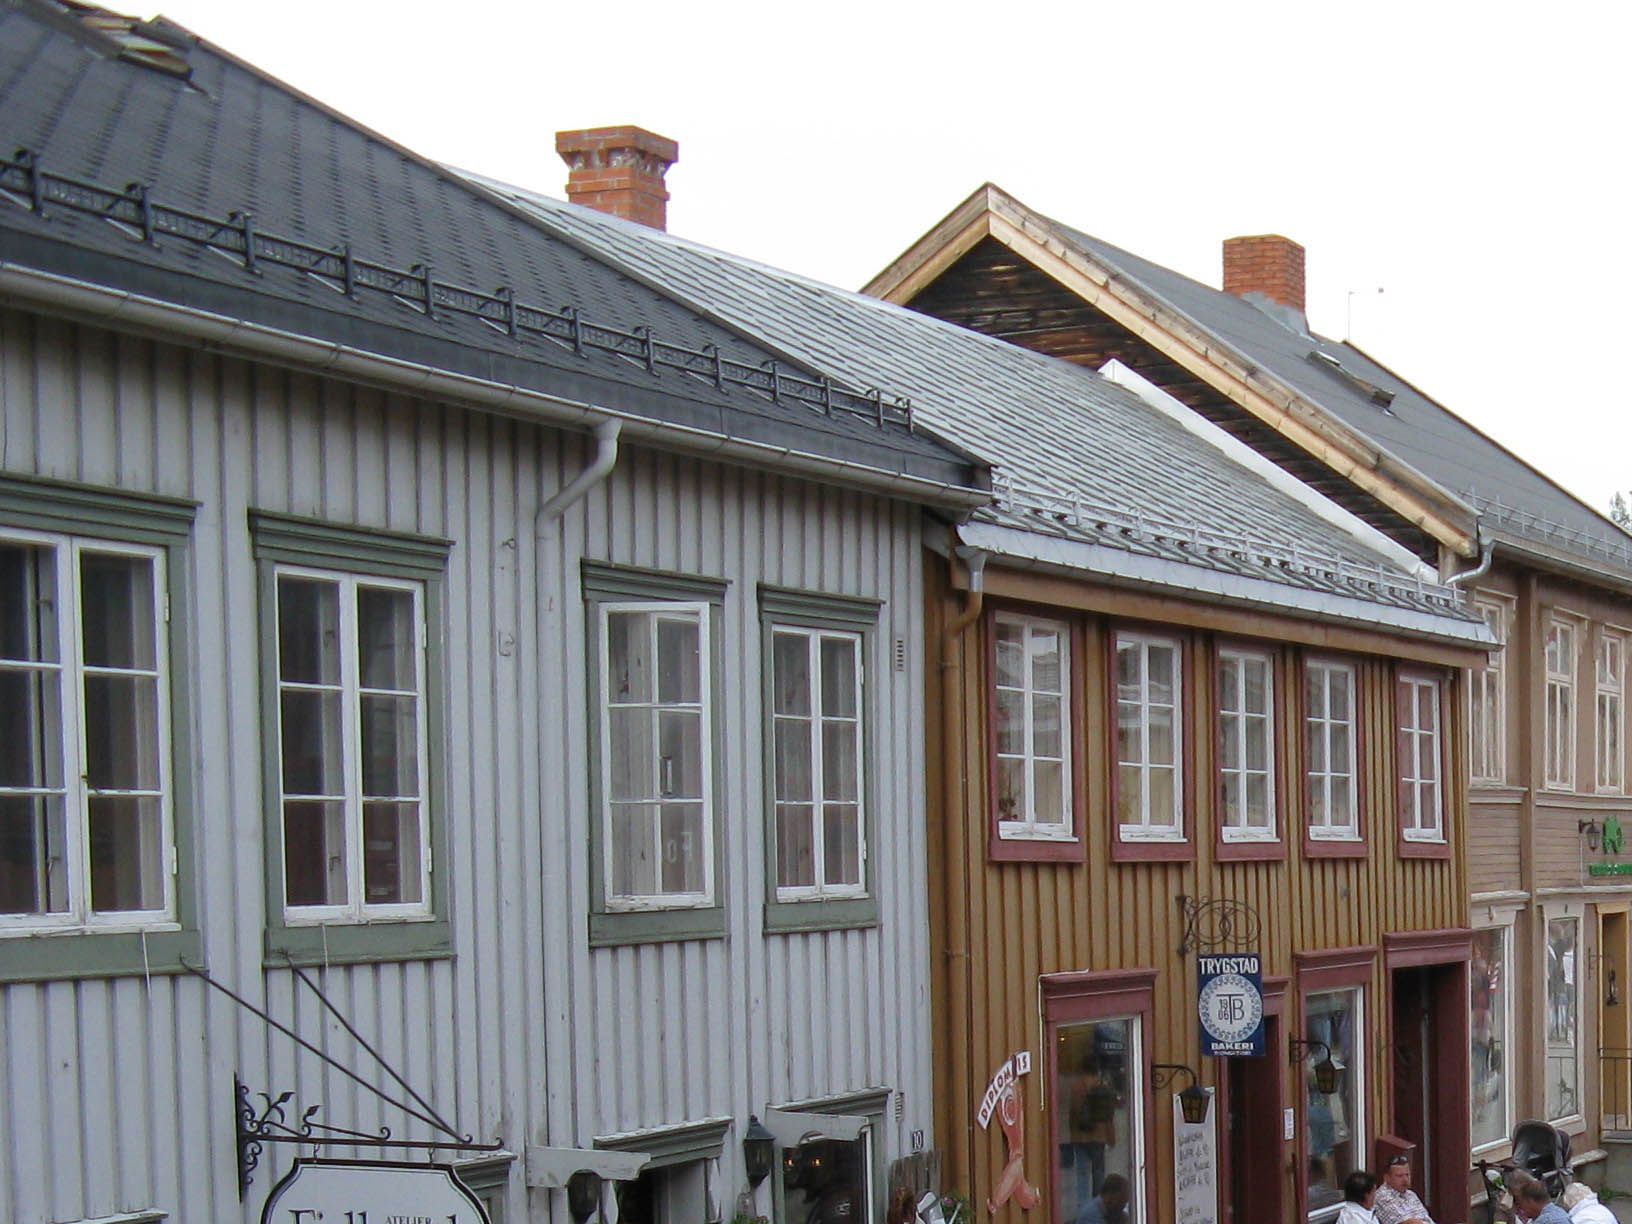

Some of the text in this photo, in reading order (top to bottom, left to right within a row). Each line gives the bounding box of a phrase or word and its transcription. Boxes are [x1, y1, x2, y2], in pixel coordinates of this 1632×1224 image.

[1199, 957, 1258, 975] TRYGSTAD
[1211, 1042, 1254, 1051] BAKERI
[912, 1130, 924, 1150] 10
